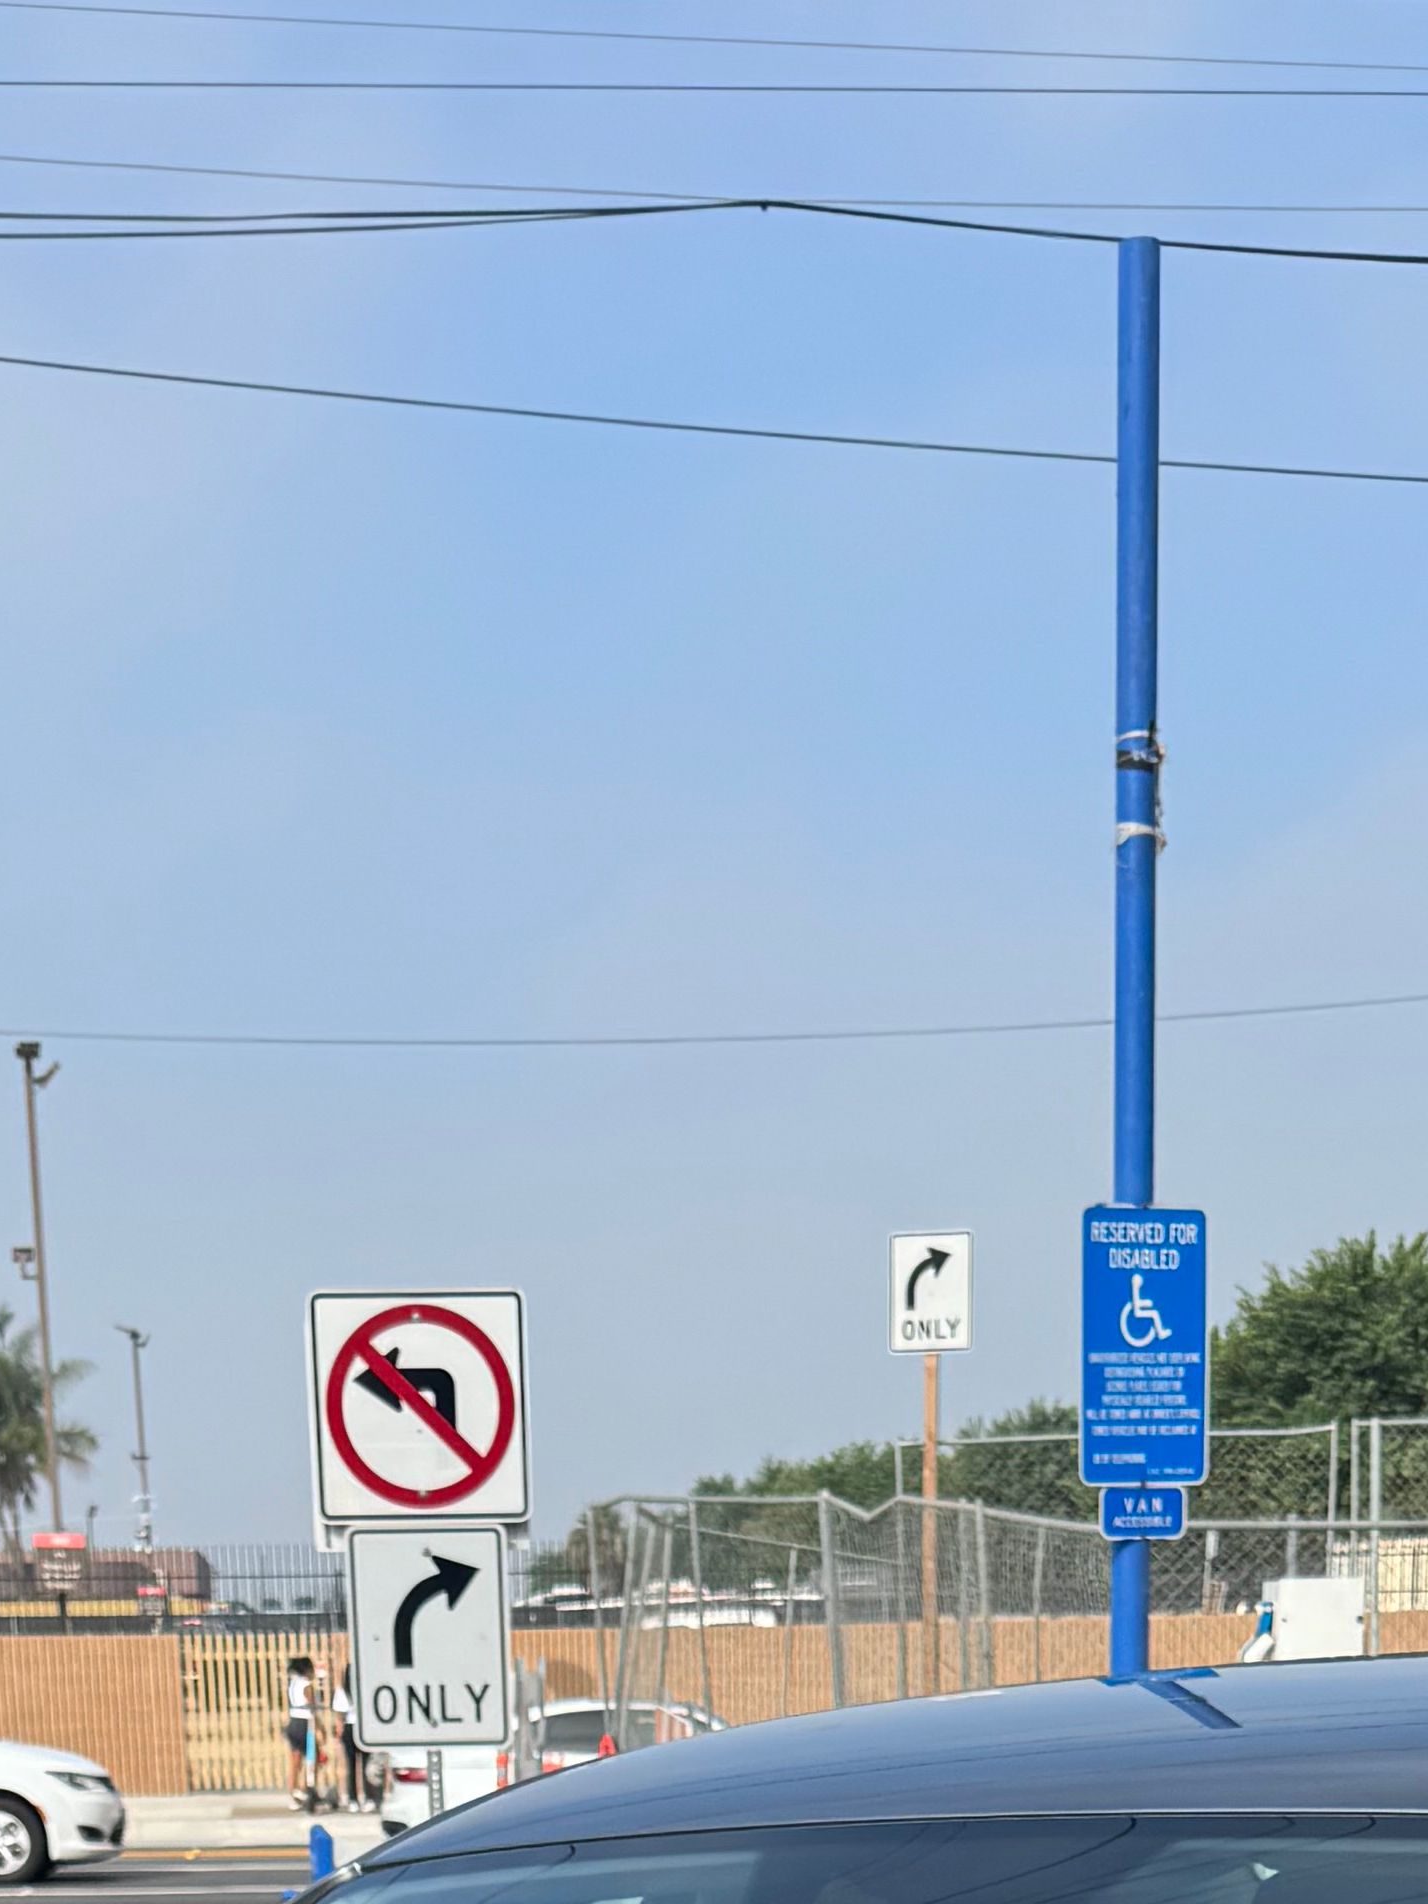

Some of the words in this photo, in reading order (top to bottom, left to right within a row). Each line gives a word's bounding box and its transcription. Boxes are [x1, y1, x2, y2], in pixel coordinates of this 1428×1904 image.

[1090, 1221, 1166, 1245] RESERVED
[1169, 1222, 1199, 1245] FOR
[1108, 1247, 1181, 1270] DISABLED
[900, 1317, 961, 1342] ONLY
[1123, 1496, 1164, 1514] VAN
[372, 1682, 491, 1725] ONLY
